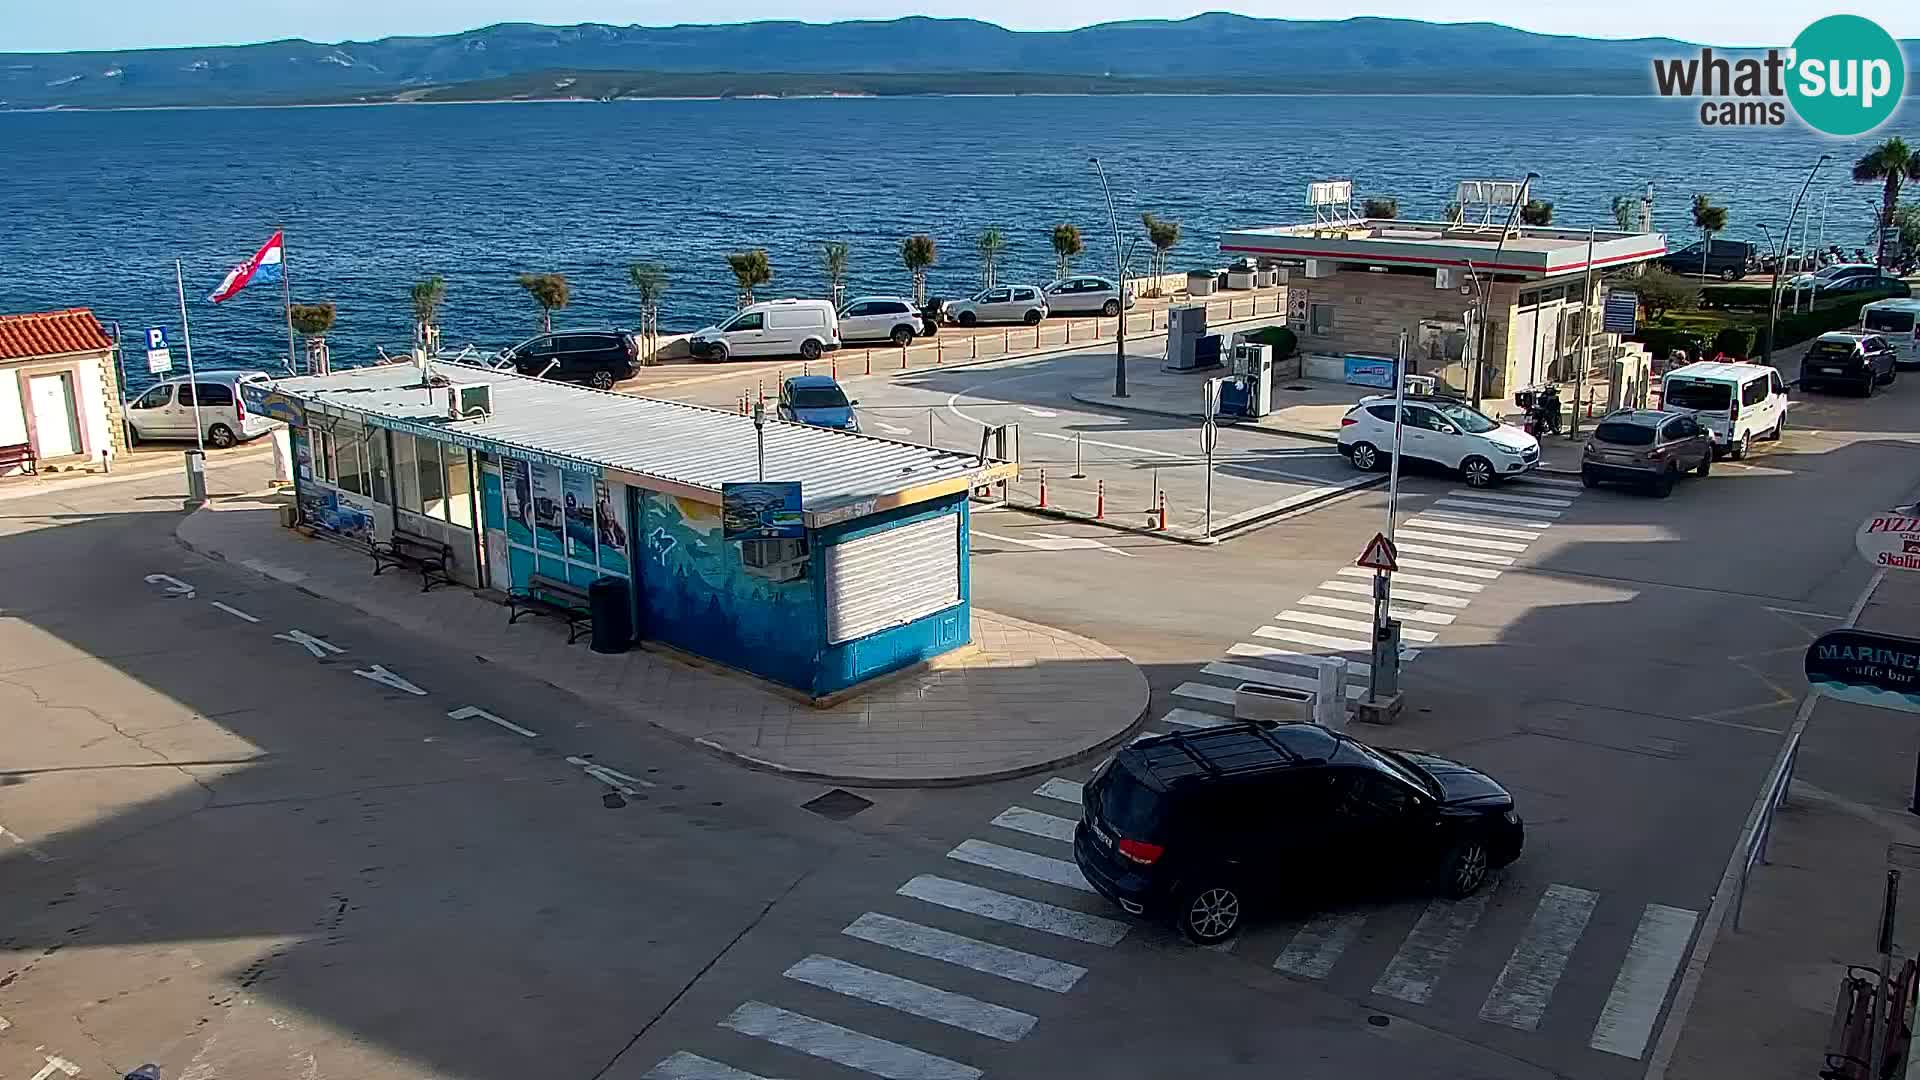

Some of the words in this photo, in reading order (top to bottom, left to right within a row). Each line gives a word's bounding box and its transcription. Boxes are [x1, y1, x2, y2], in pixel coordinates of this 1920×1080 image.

[149, 329, 163, 348] P
[495, 445, 510, 457] BUS
[511, 448, 543, 464] STATION
[544, 455, 571, 470] TICKET
[572, 462, 599, 476] OFFICE
[1887, 667, 1916, 684] bar
